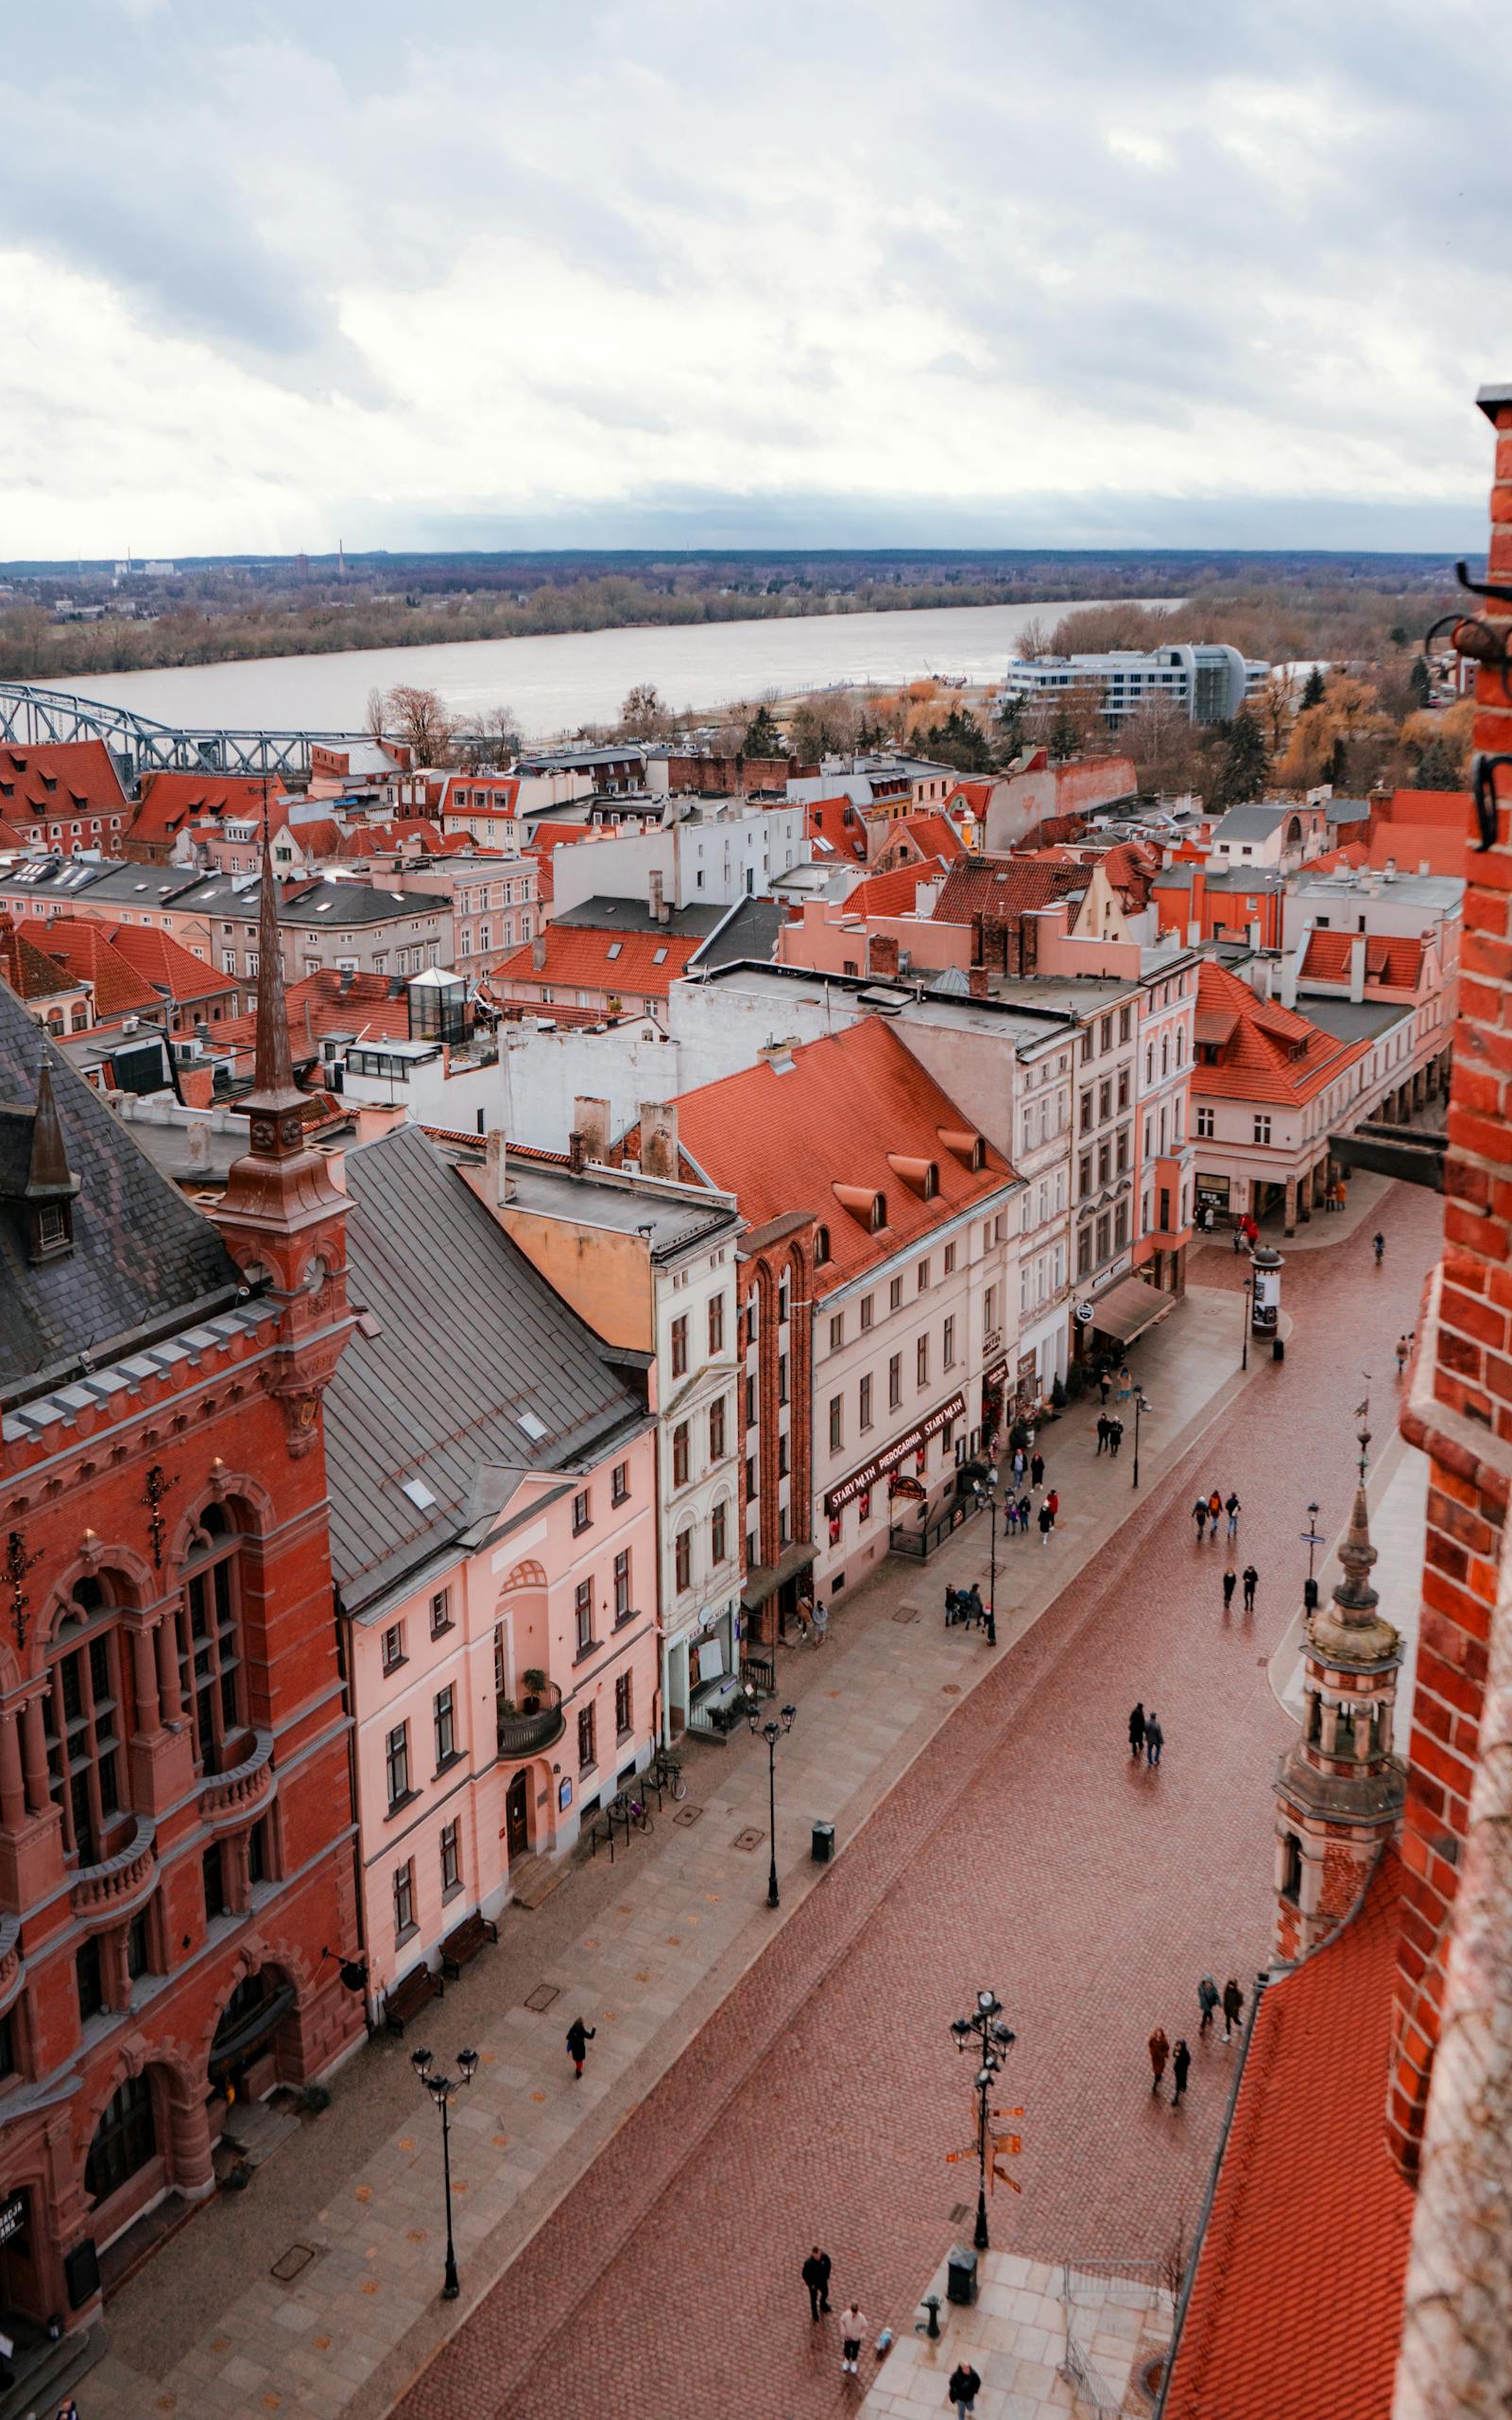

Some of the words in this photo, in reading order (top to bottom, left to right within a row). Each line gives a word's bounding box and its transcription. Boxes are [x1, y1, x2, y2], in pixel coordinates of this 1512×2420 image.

[832, 1480, 854, 1507] STARY
[878, 1431, 922, 1469] PIEROGARNIA
[924, 1411, 945, 1435] STARY
